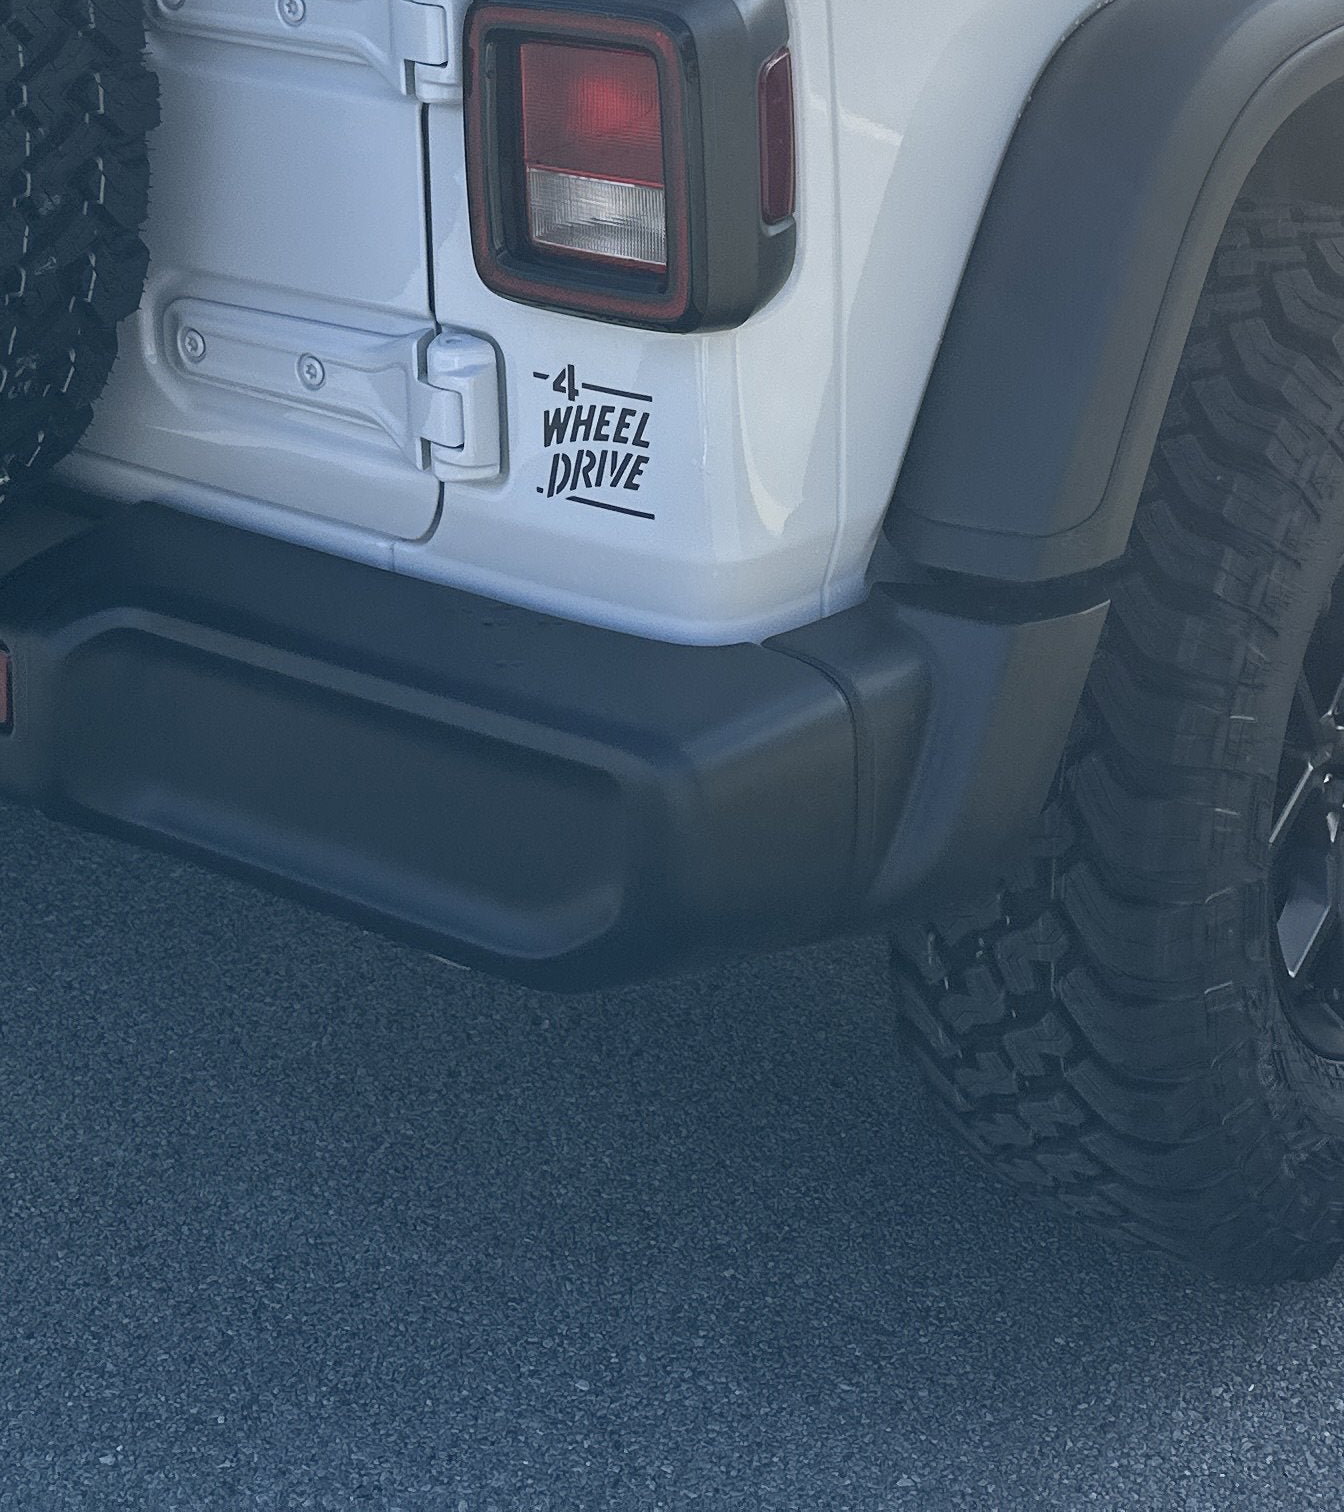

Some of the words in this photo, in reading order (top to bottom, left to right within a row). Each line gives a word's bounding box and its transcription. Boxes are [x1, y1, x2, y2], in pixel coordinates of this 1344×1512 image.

[552, 363, 580, 402] 4
[543, 404, 651, 449] WHEEL
[546, 449, 650, 499] DRIVE
